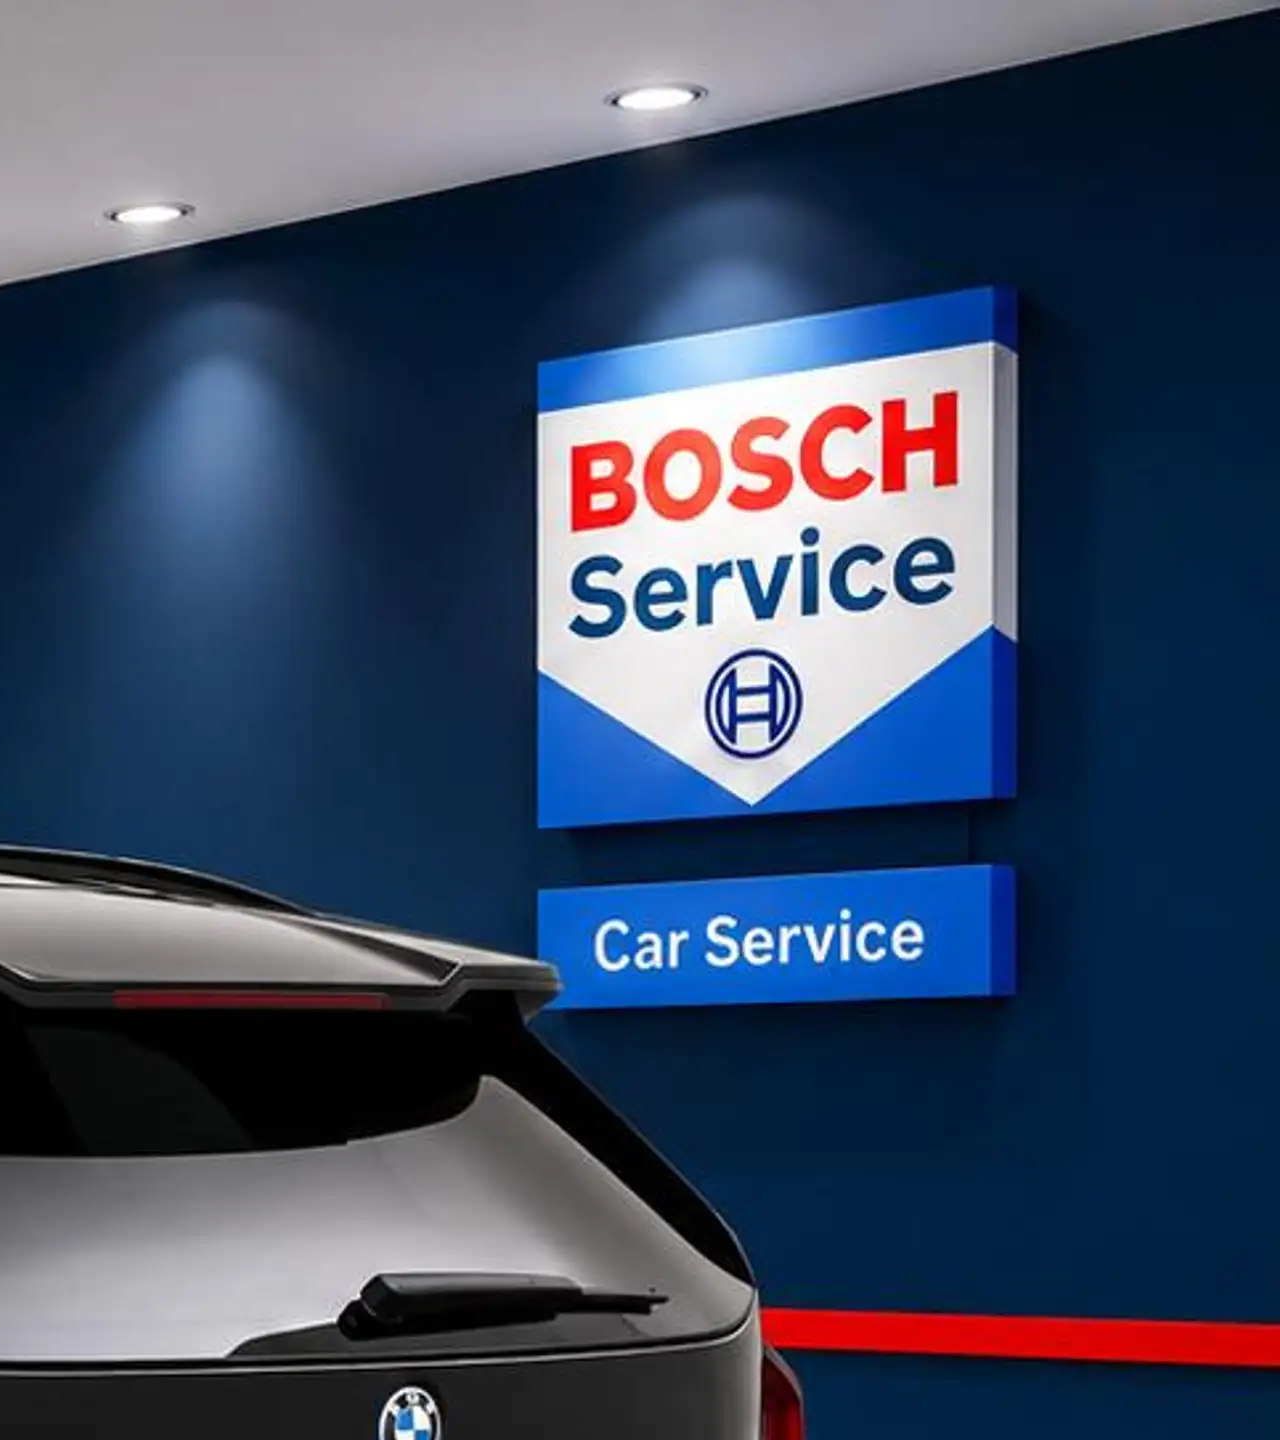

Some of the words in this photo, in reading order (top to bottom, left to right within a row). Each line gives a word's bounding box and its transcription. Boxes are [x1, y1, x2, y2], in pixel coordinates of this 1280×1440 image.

[570, 391, 959, 533] BOSCH
[568, 527, 957, 639] Service
[594, 919, 690, 972] Car
[705, 909, 925, 967] Service
